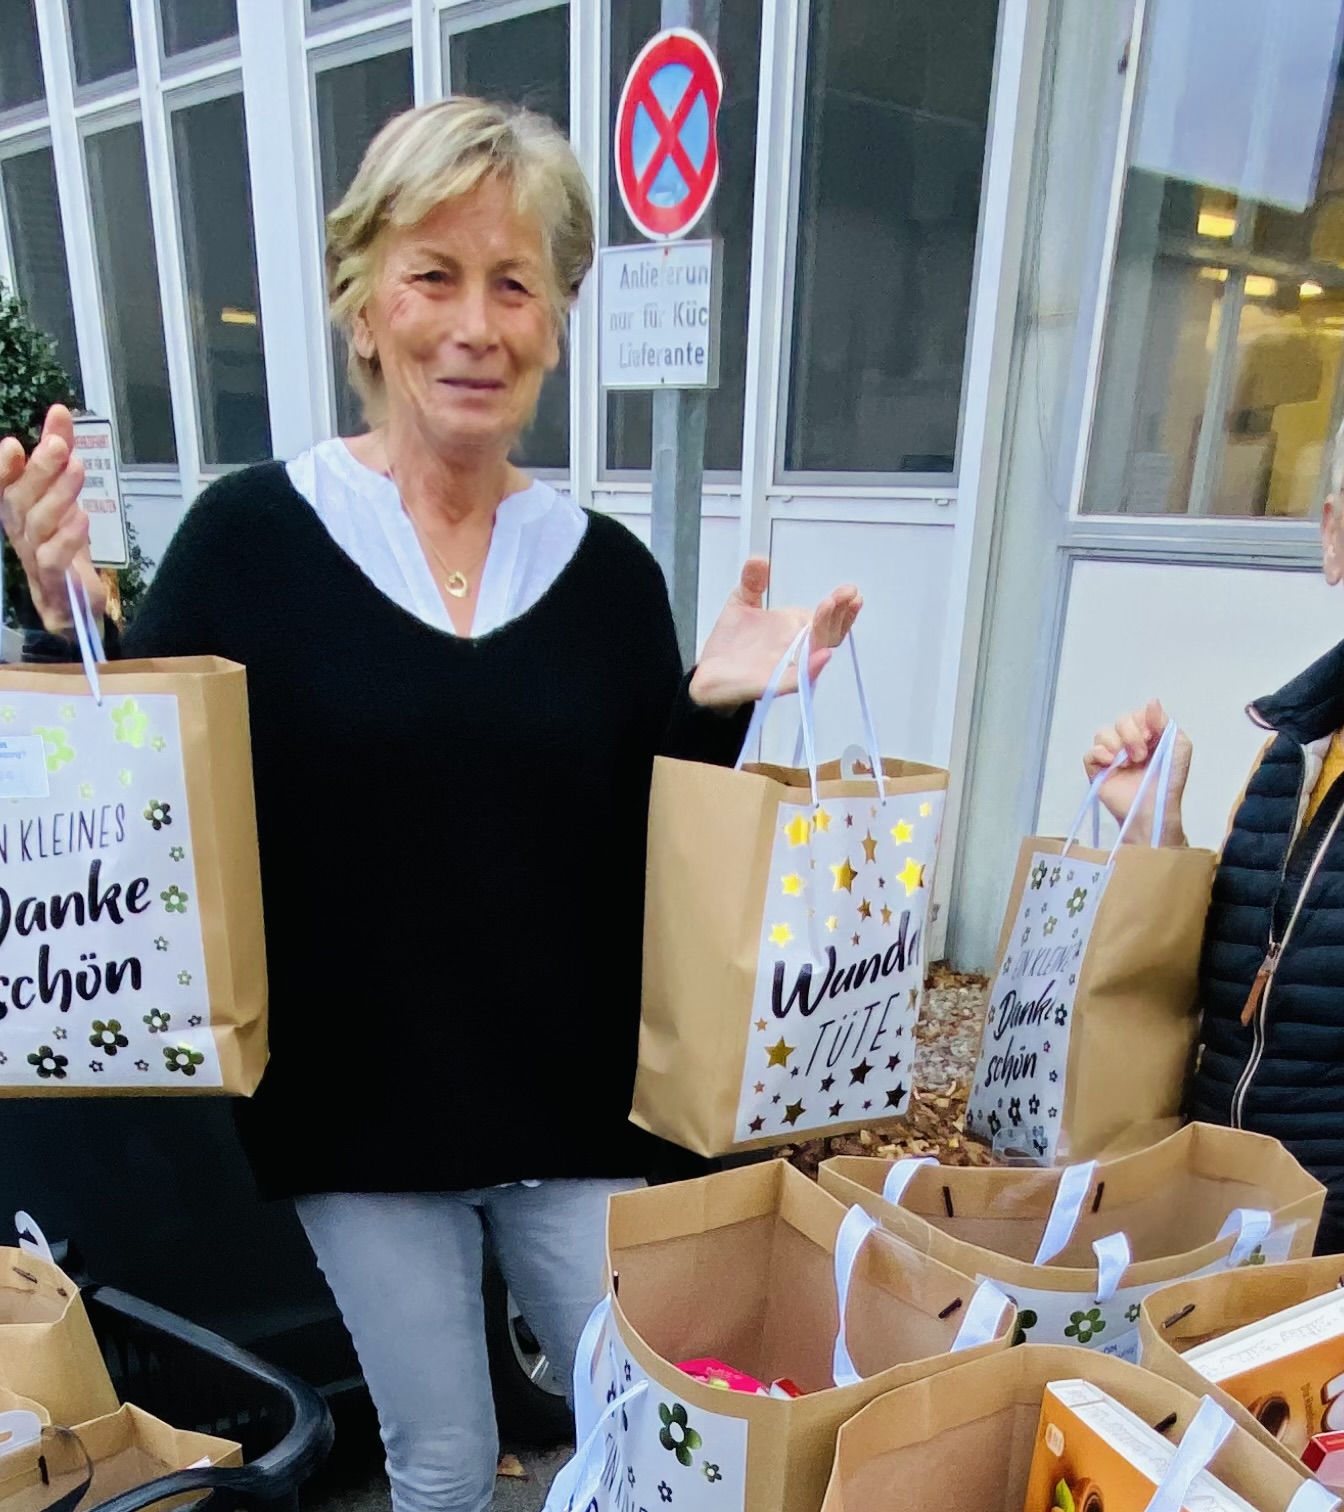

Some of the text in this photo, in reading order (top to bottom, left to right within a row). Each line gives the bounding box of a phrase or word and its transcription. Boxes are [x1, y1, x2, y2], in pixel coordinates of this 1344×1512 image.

[619, 262, 709, 290] Anlieerun
[20, 803, 125, 862] KLEINES
[805, 992, 901, 1077] TÜTE
[993, 979, 1054, 1041] Danke
[984, 1036, 1038, 1088] schön
